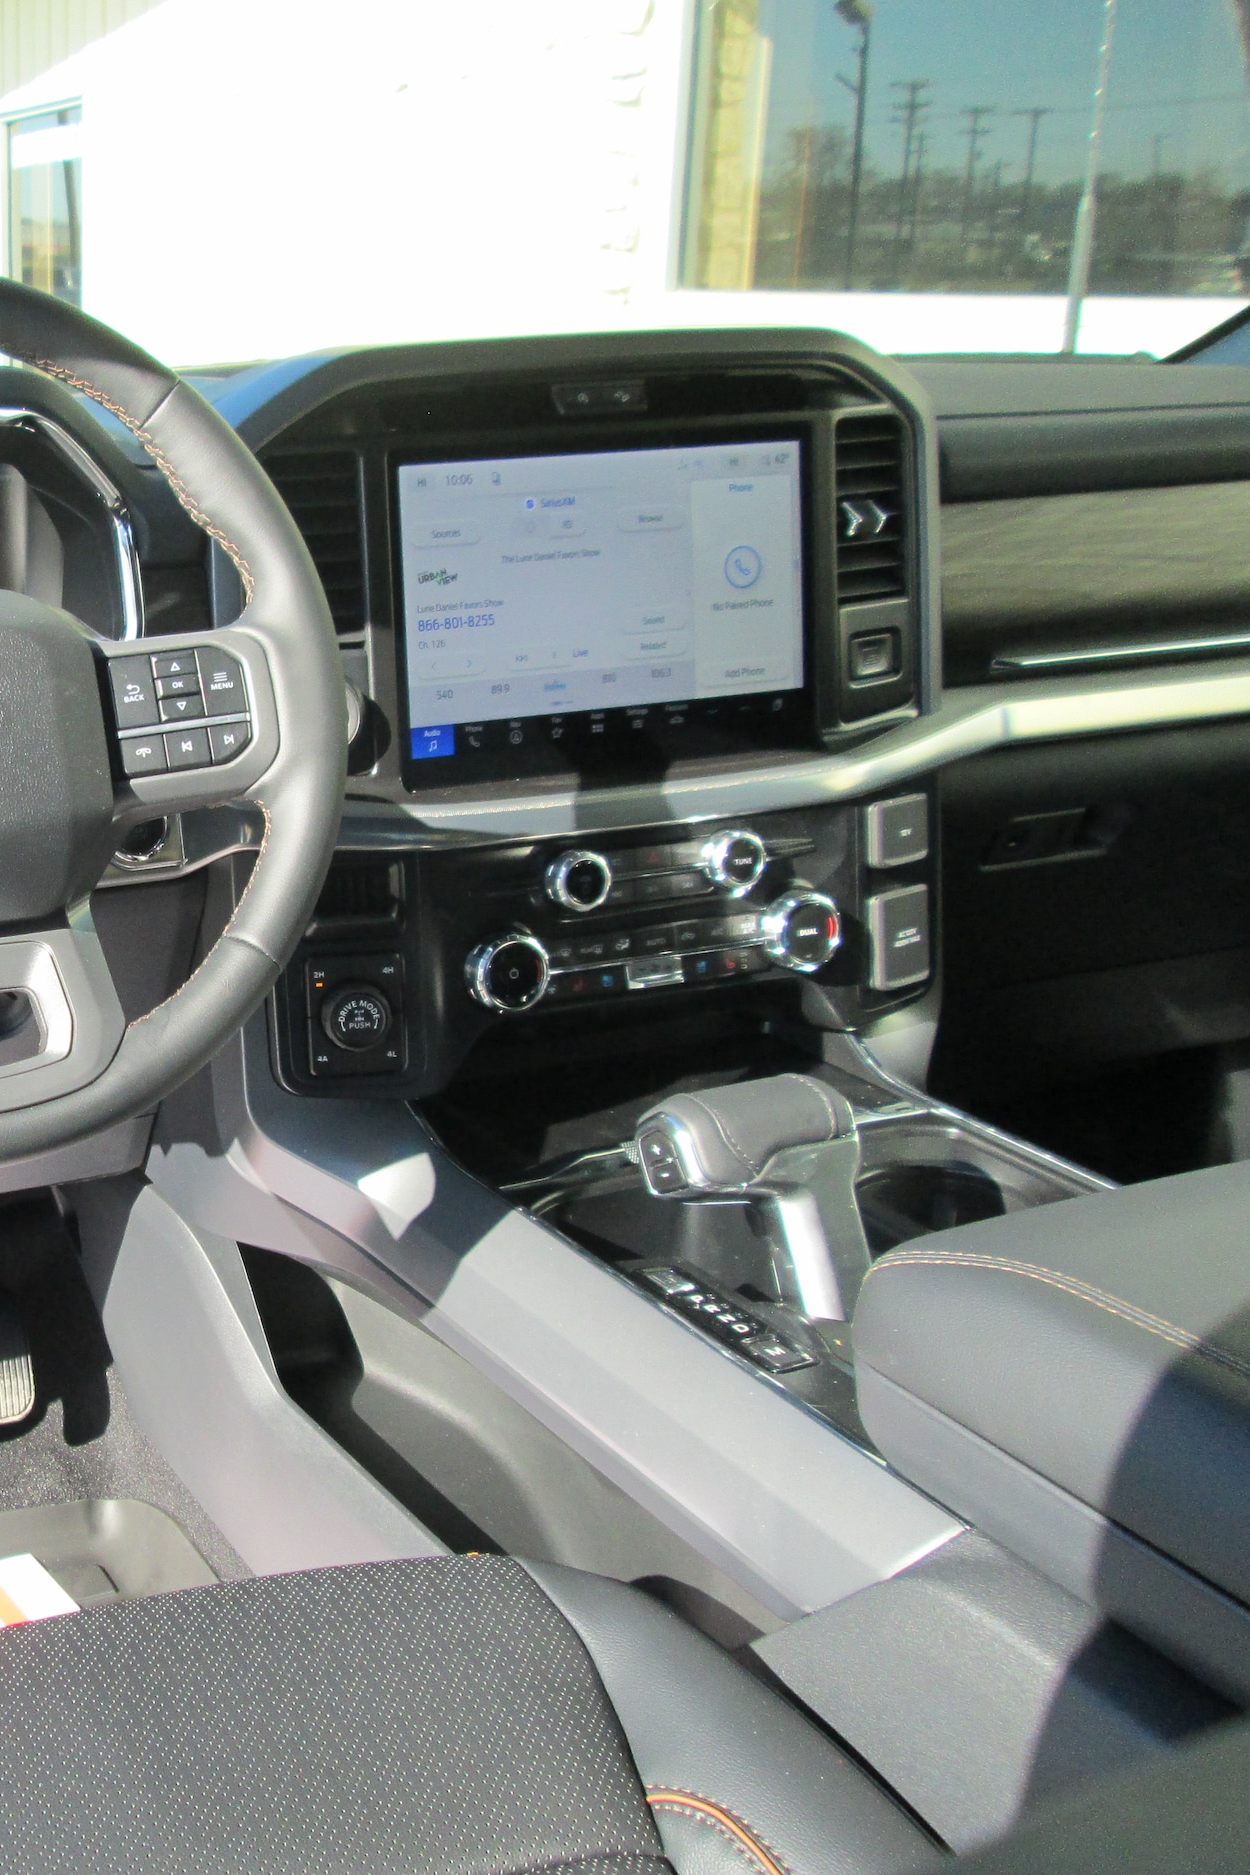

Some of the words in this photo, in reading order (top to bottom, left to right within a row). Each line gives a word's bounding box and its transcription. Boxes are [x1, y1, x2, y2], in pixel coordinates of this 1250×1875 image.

[446, 474, 473, 485] 10:06
[729, 483, 753, 492] Phone
[431, 529, 461, 539] Sources
[436, 602, 458, 611] Daniel
[485, 599, 504, 607] Show
[712, 603, 724, 611] No
[750, 599, 774, 608] Phone
[418, 614, 495, 632] 866-801-8255
[432, 640, 446, 649] 126
[725, 669, 740, 678] Add
[741, 667, 766, 676] Phone
[211, 682, 234, 690] MENU
[491, 683, 510, 694] 89.9
[124, 694, 145, 703] BACK
[436, 689, 453, 700] 540
[424, 729, 441, 738] Audio
[734, 858, 753, 866] TUNE
[799, 928, 819, 937] DUAL
[313, 971, 325, 979] 2H
[338, 1000, 358, 1023] DRIVE
[359, 1000, 381, 1019] MODE
[349, 1021, 371, 1029] PUSH
[764, 1346, 786, 1357] M
